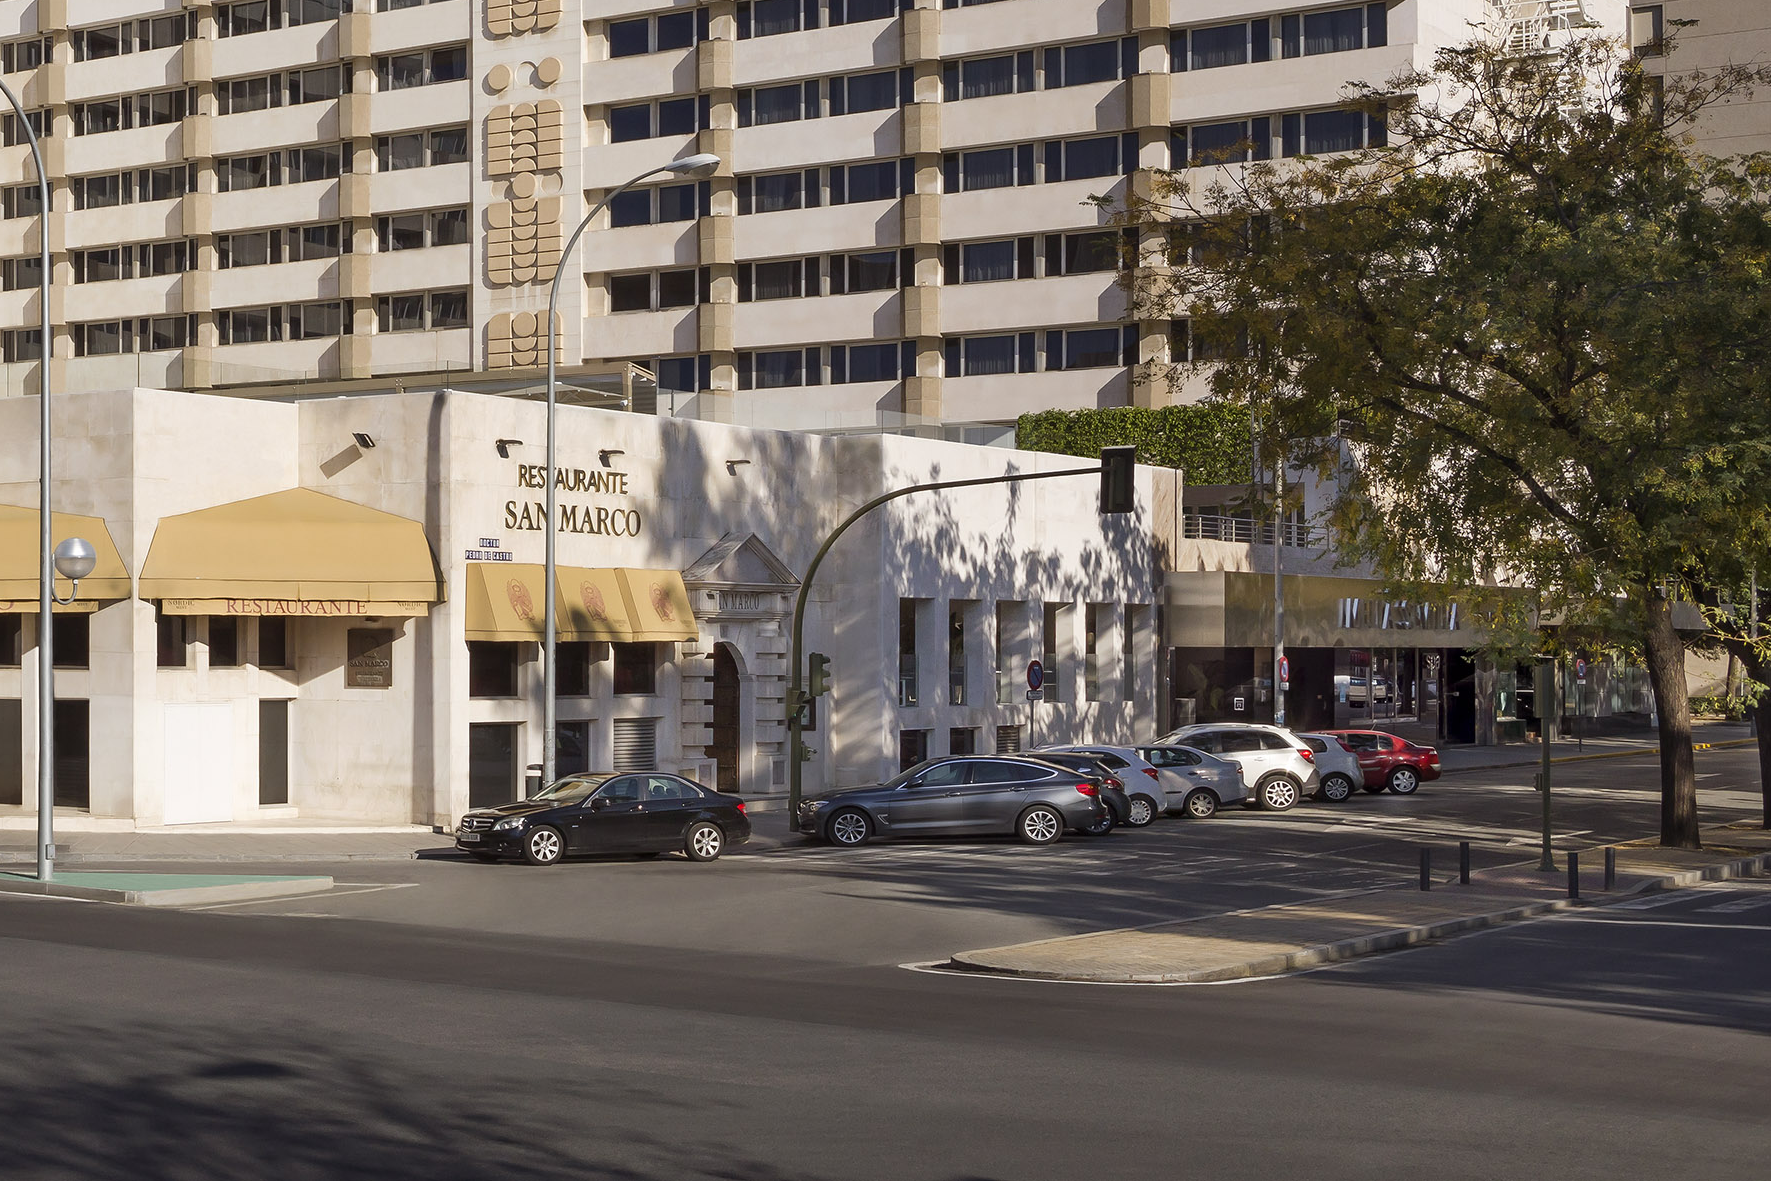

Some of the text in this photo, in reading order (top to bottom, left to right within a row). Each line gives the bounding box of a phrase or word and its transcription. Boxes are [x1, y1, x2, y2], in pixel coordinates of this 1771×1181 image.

[517, 464, 628, 495] RESAURANTE
[558, 504, 642, 538] MARCO
[226, 599, 368, 614] RESTAURANTE
[731, 593, 760, 610] MARCO
